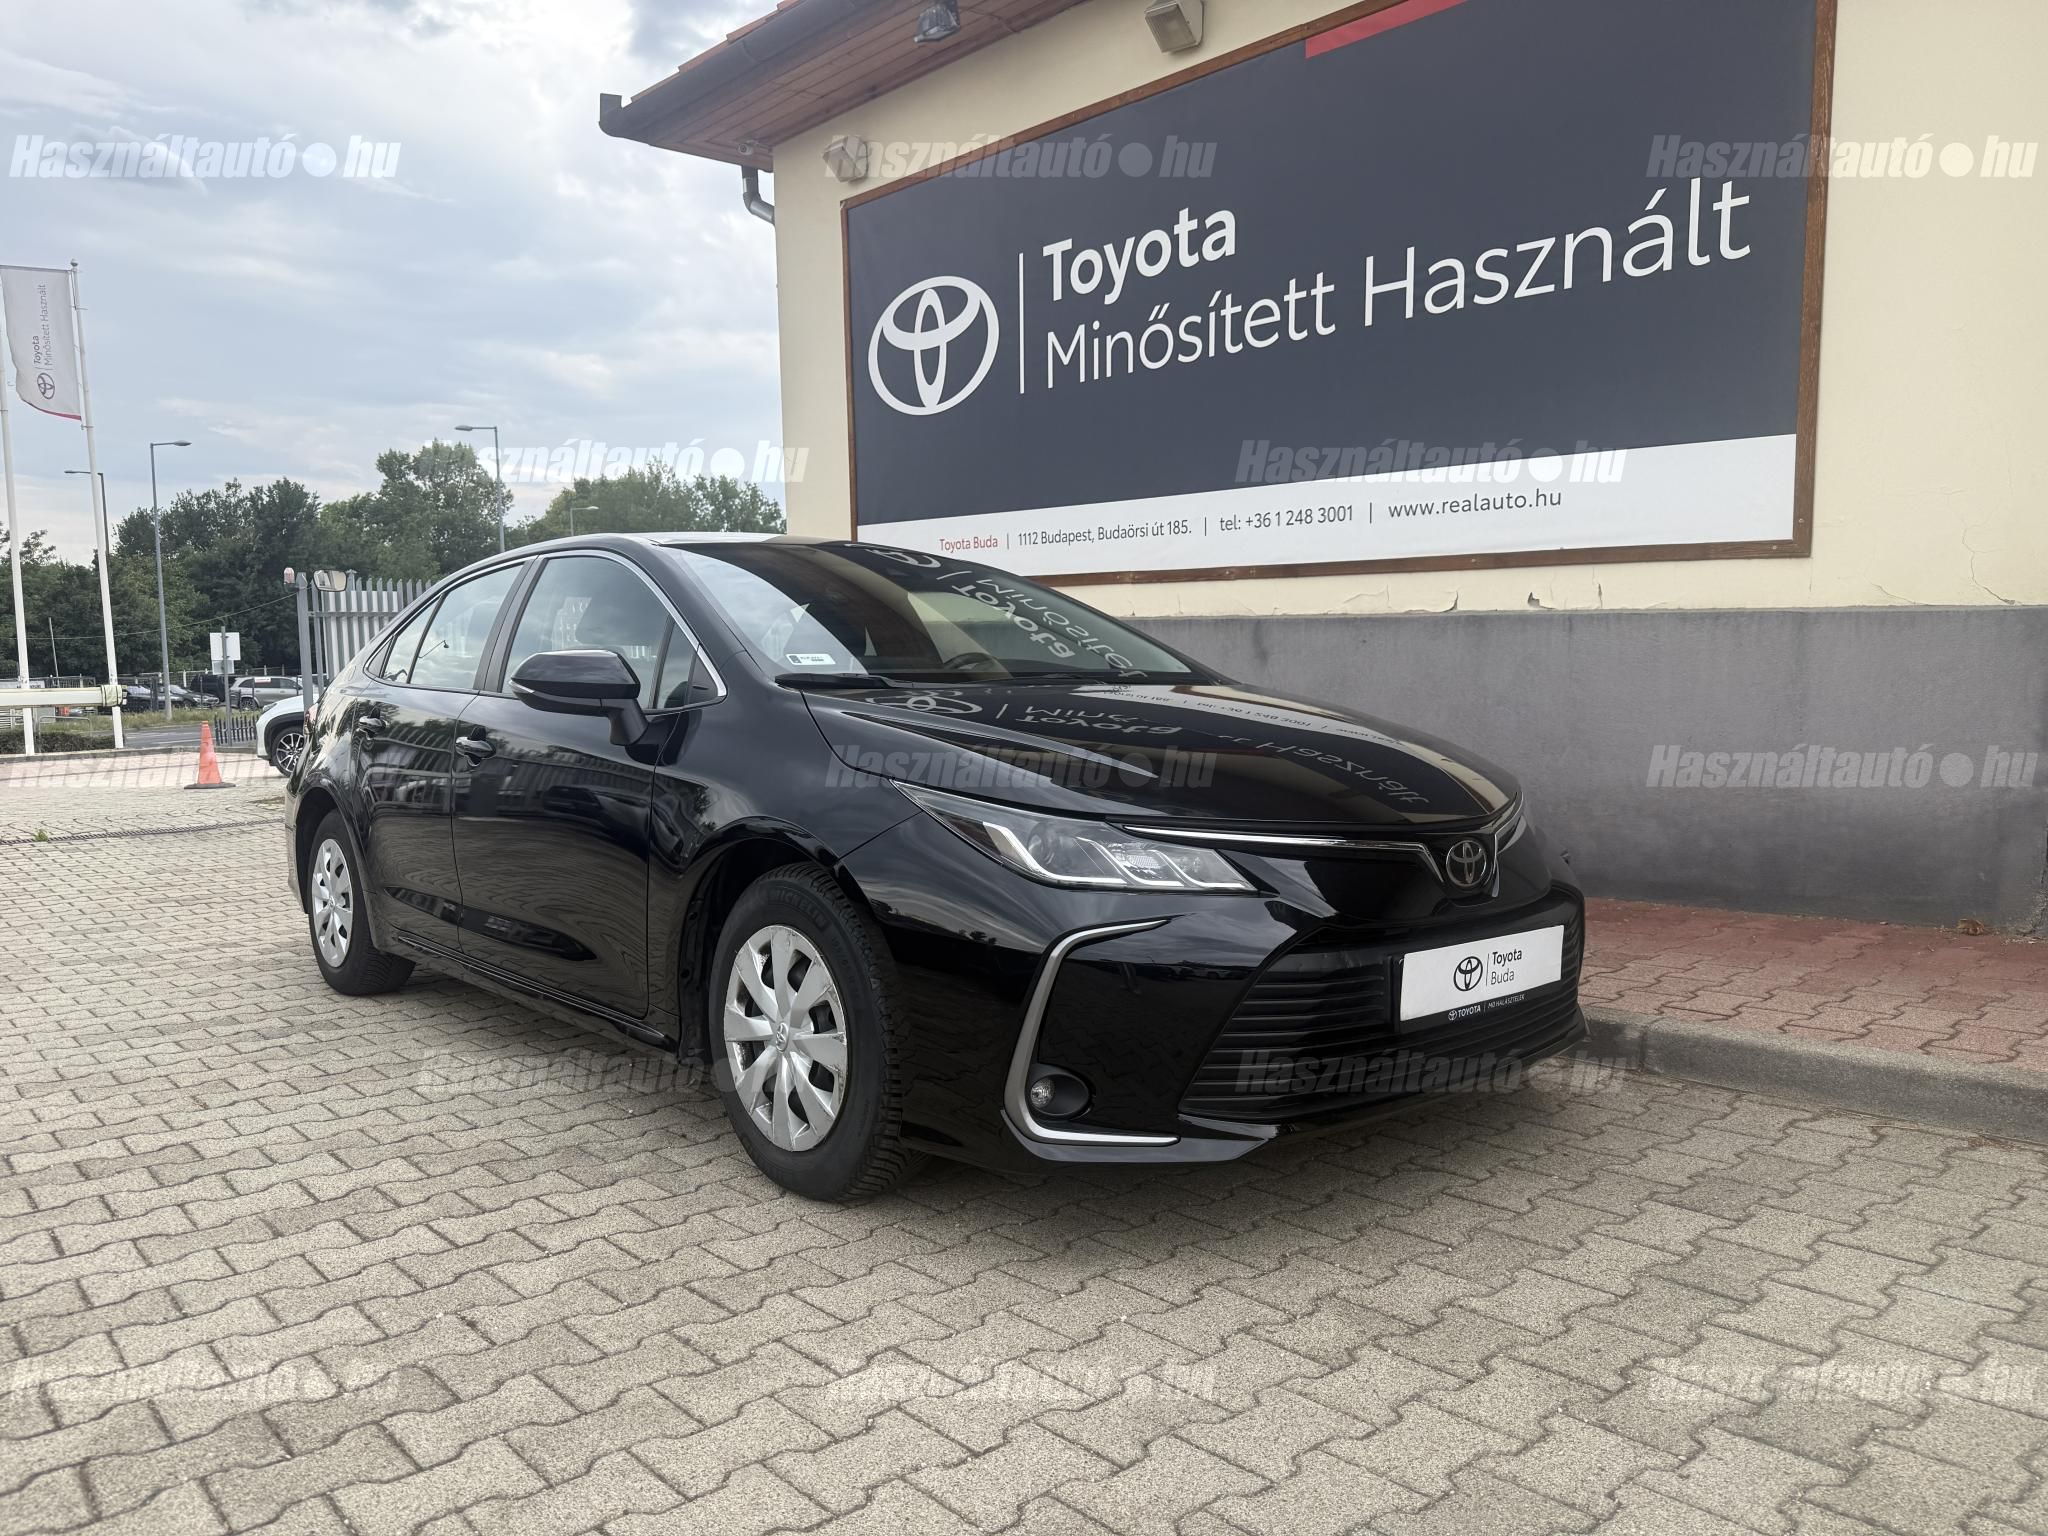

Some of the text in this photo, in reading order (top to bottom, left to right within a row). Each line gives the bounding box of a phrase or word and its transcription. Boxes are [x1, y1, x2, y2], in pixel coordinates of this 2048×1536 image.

[1043, 207, 1236, 305] Toyota
[1047, 177, 1752, 389] Minősített Használt
[31, 335, 41, 364] Toyota
[1388, 488, 1562, 518] www.realauto.hu
[1220, 514, 1241, 532] tel:
[1245, 511, 1271, 529] +36
[1286, 508, 1313, 526] 248
[1317, 505, 1353, 524] 3001
[940, 534, 999, 554] Toyota Buda
[1018, 519, 1192, 546] 1112 Budapest, Budaörsi út 185.
[1492, 949, 1522, 967] Toyota
[1490, 968, 1515, 985] Buda
[1457, 1005, 1481, 1018] TOYOTA
